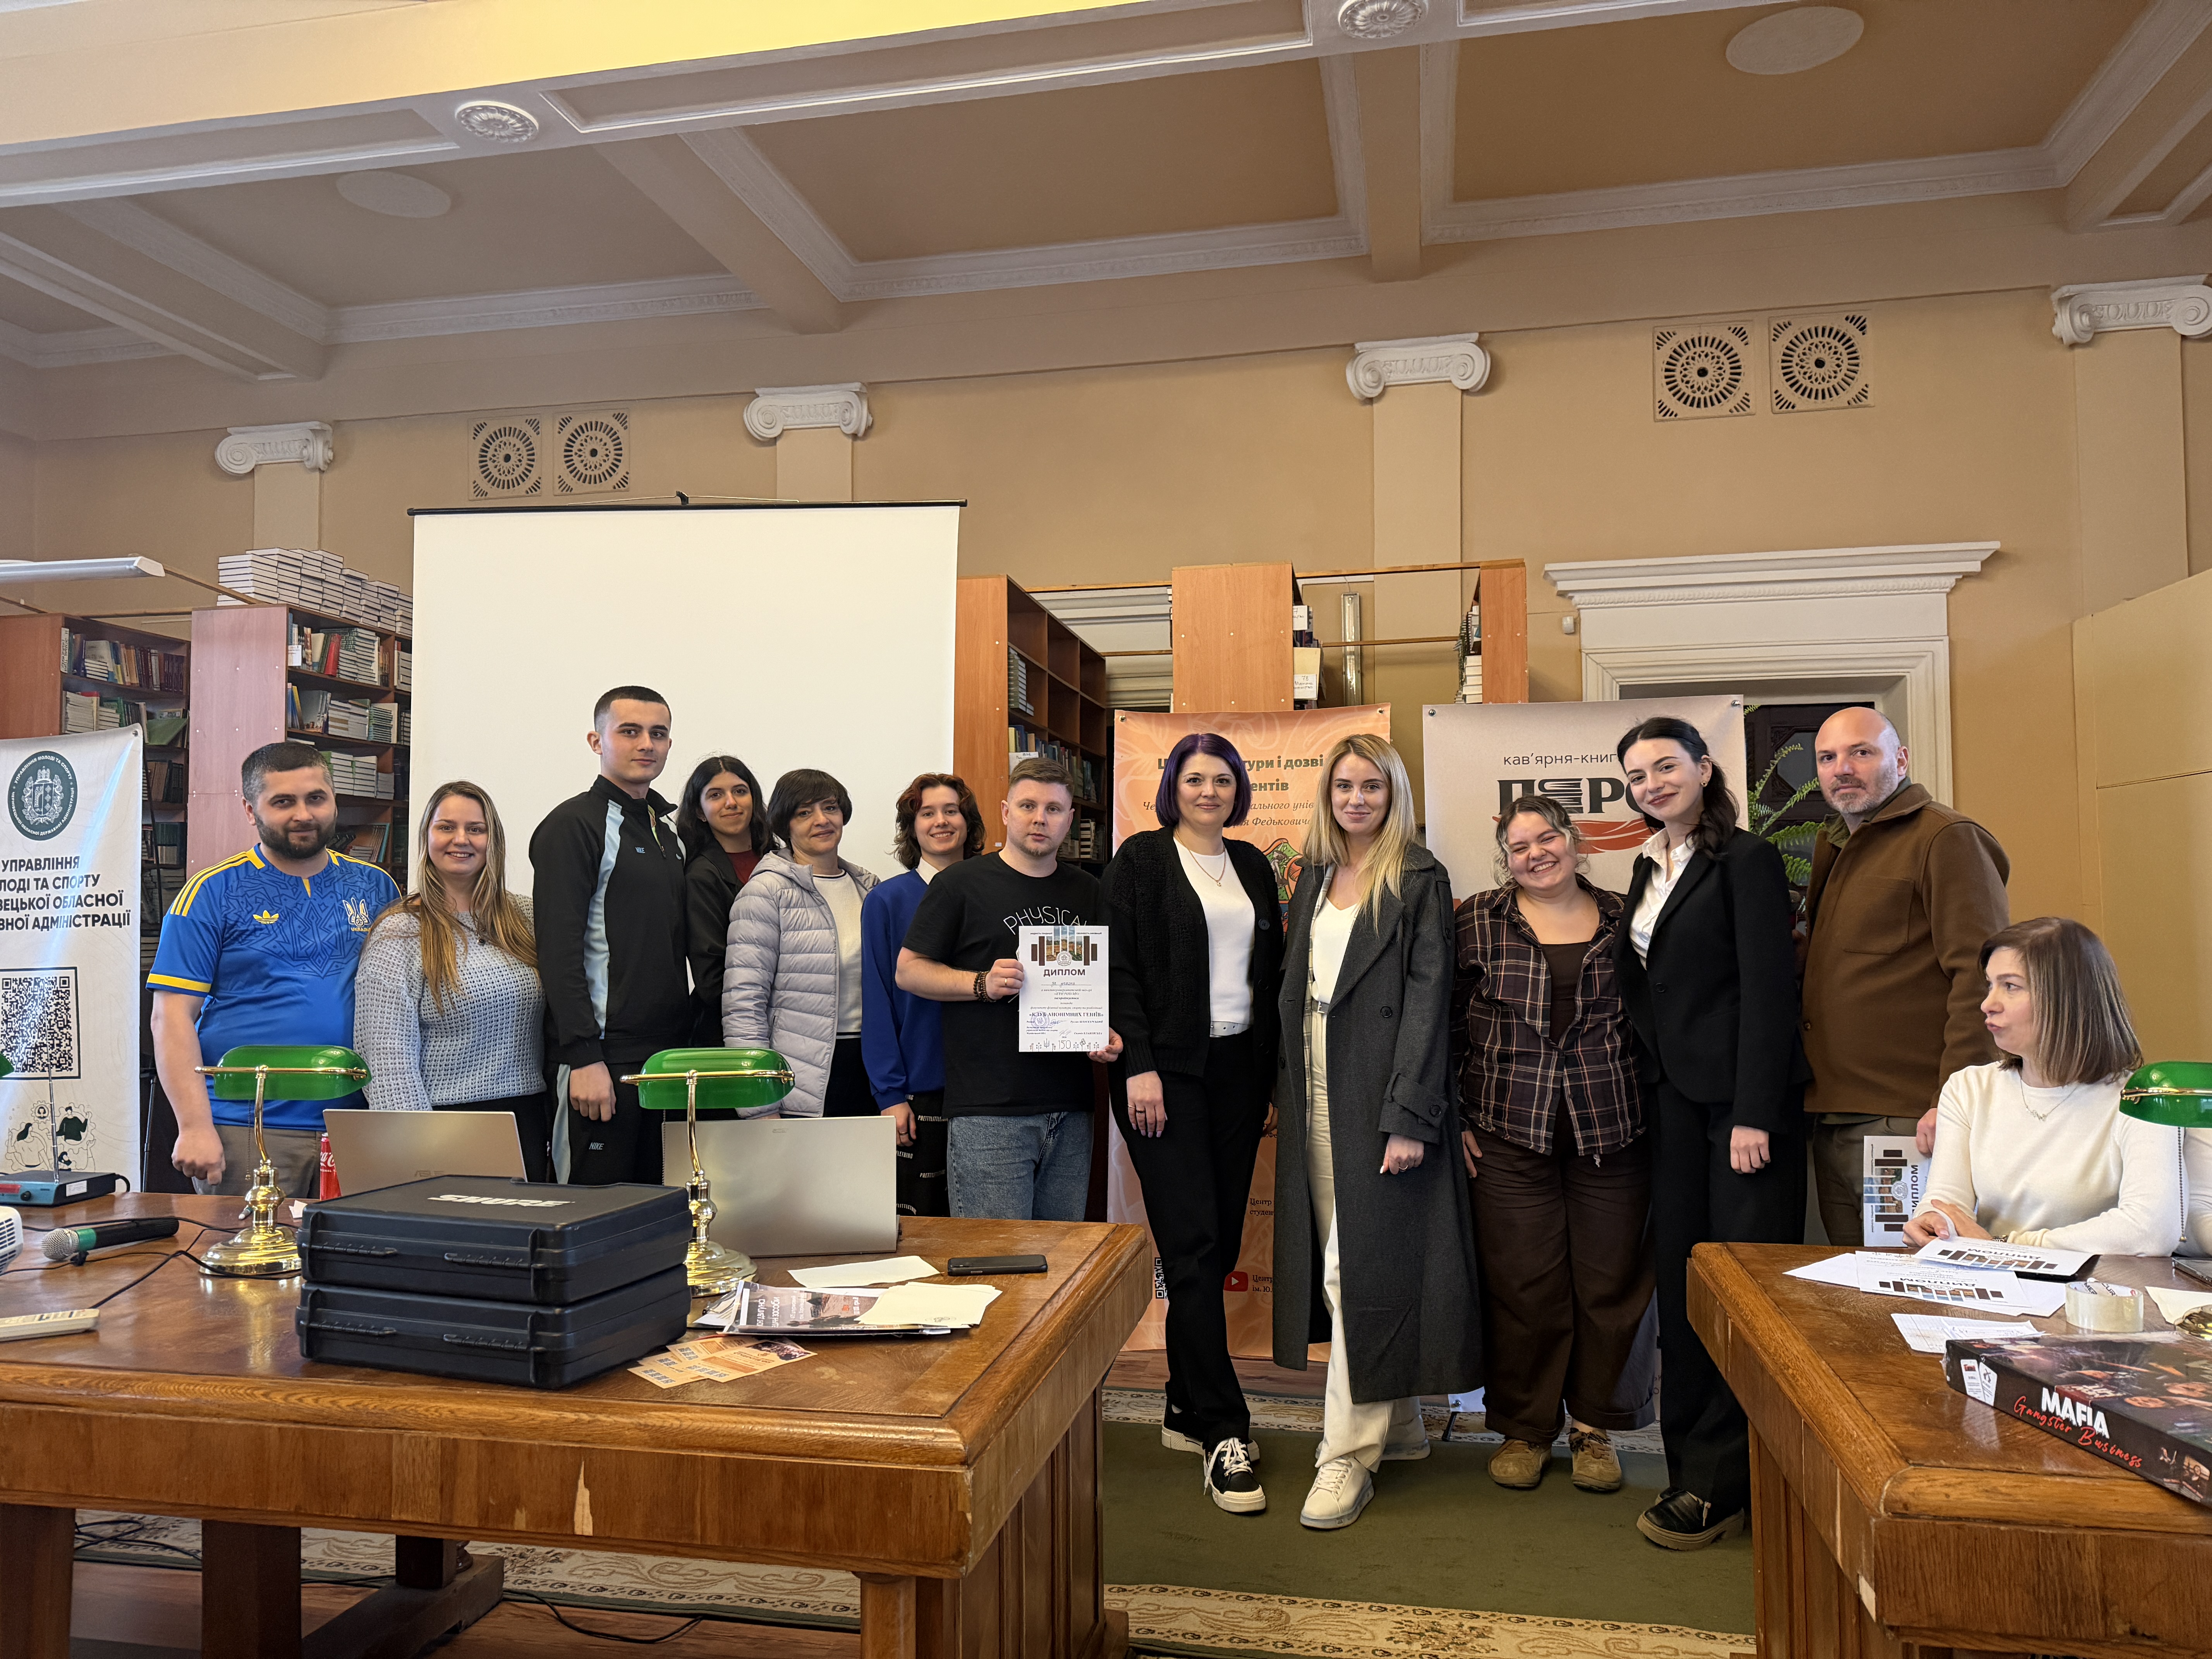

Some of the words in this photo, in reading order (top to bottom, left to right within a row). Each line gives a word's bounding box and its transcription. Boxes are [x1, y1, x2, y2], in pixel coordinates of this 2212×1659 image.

[1277, 755, 1281, 768] і
[14, 757, 37, 784] УПРАВЛІННЯ
[61, 762, 73, 780] СПОРТУ
[1, 856, 80, 872] УПРАВЛІННЯ
[33, 878, 49, 890] ТА
[52, 874, 101, 890] СПОРТУ
[53, 890, 124, 909] ОБЛАСНОЇ
[32, 909, 131, 932] АДМІНІСТРАЦІЇ
[1003, 906, 1087, 935] PHYSICA
[1044, 969, 1085, 977] ДИПЛОМ
[1058, 1040, 1071, 1049] 150
[427, 1194, 571, 1207] SHURE
[1250, 1198, 1272, 1206] Центр
[1967, 1248, 2041, 1260] ДИПЛОМ
[1900, 1278, 1977, 1287] ДИПЛОМ
[2041, 1387, 2110, 1439] MAFIA
[2014, 1396, 2072, 1433] Gangster
[2078, 1426, 2142, 1468] Business
